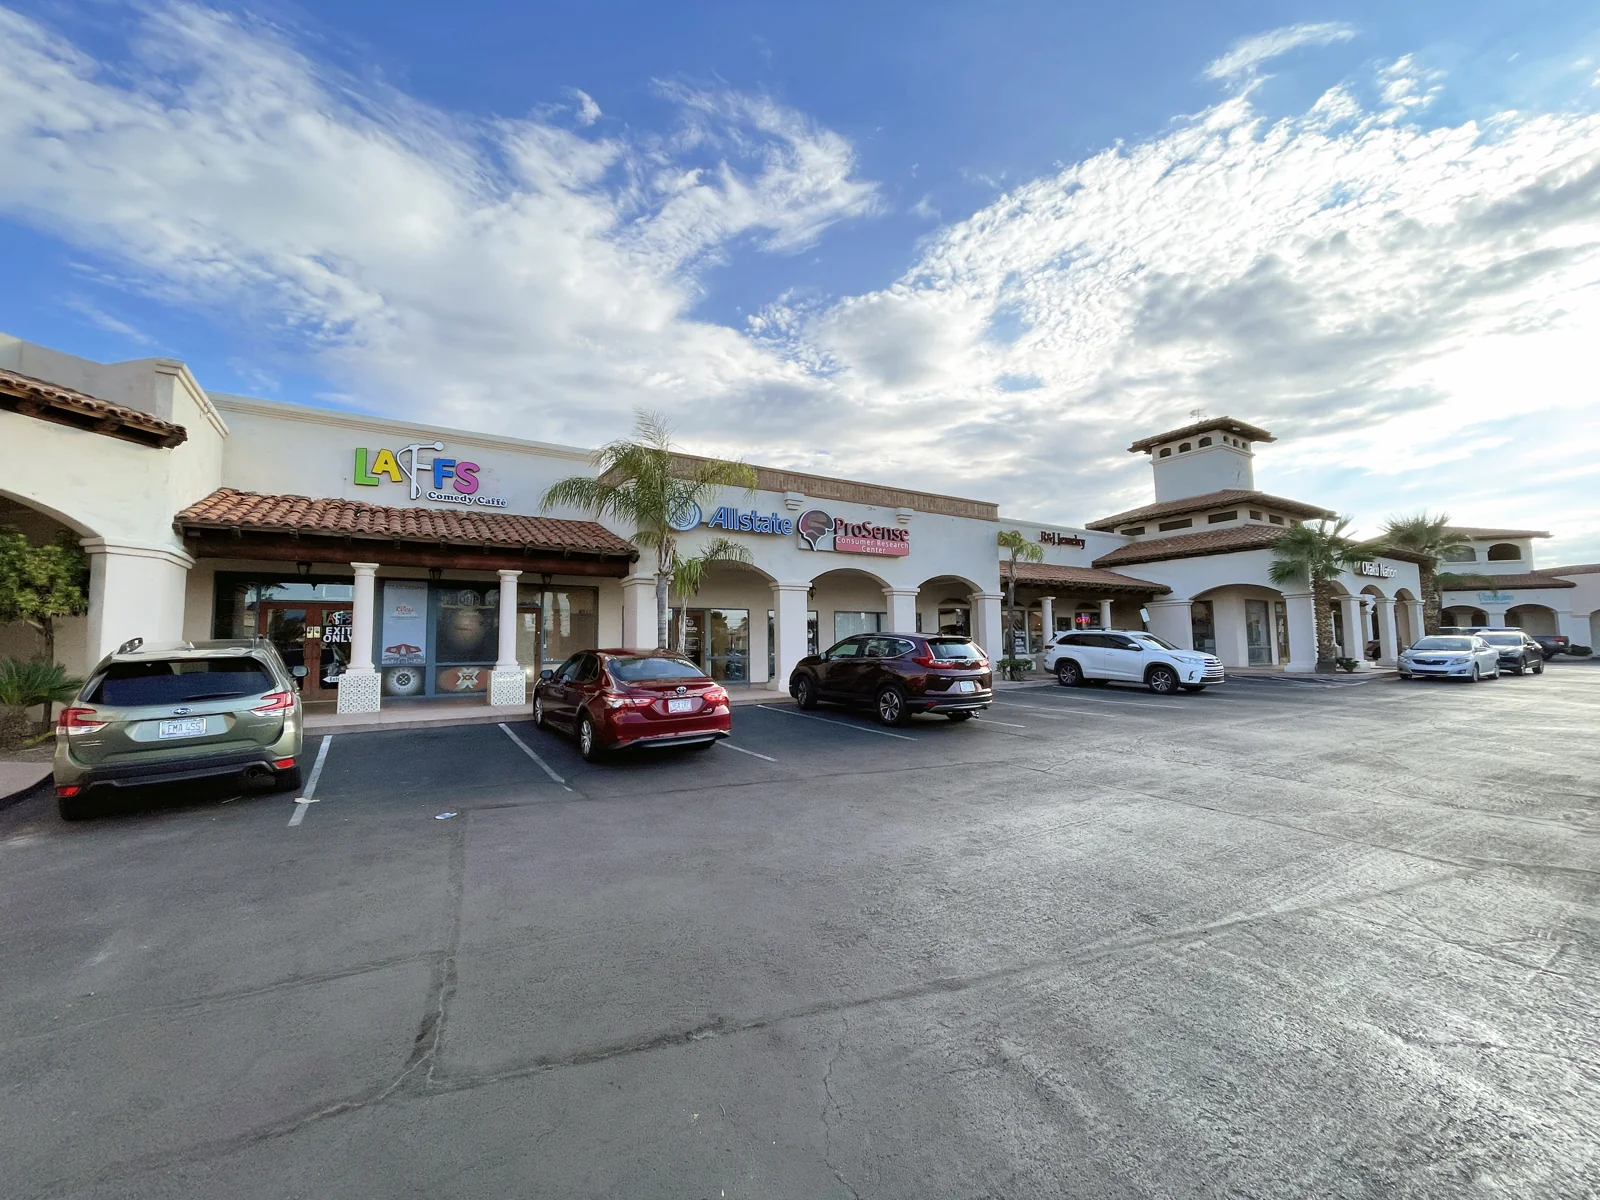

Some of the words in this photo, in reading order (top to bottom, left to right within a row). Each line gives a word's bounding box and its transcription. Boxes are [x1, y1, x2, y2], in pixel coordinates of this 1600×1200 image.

[354, 441, 481, 500] LAFFS
[427, 491, 474, 504] Comedy
[708, 506, 793, 536] Allstate
[834, 517, 910, 541] ProSense
[836, 536, 874, 546] Consumer
[876, 539, 909, 549] Research
[861, 545, 886, 554] Center
[325, 627, 352, 635] EXIT
[323, 634, 353, 643] ONLY
